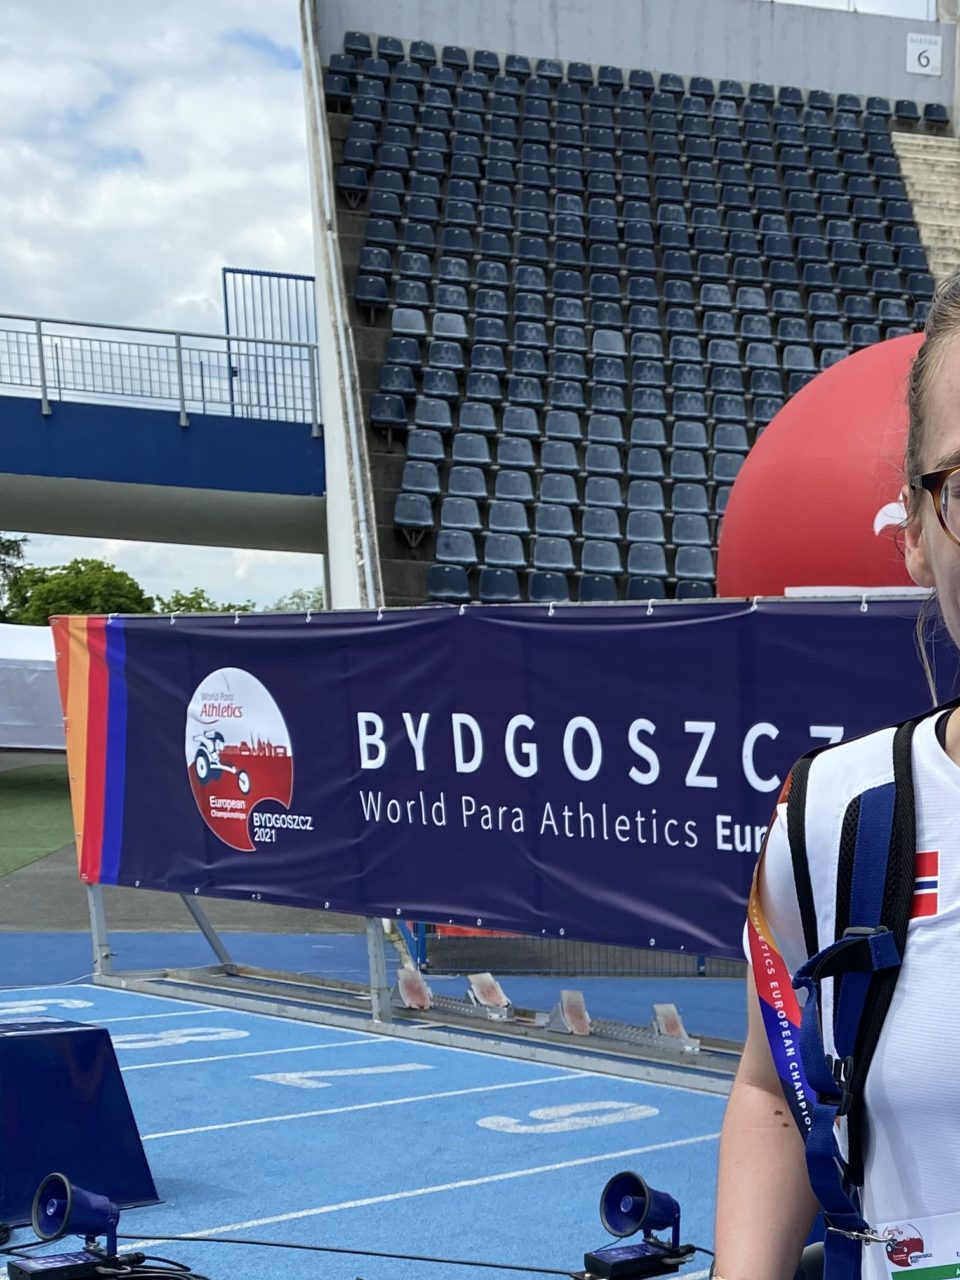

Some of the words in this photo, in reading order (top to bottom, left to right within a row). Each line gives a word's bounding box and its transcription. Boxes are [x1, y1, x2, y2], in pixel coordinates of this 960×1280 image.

[917, 49, 931, 68] 6
[200, 703, 243, 718] Athletics
[357, 711, 845, 793] BYDGOSZC
[209, 796, 246, 811] European
[253, 812, 314, 831] BYDGOSZCZ
[359, 790, 446, 826] World
[461, 795, 525, 833] Para
[539, 801, 698, 848] Athletics
[254, 828, 276, 842] 2021
[752, 899, 776, 976] ATHLETICS
[769, 981, 796, 1057] EUROPEAN
[789, 1061, 813, 1132] CHAMPIO
